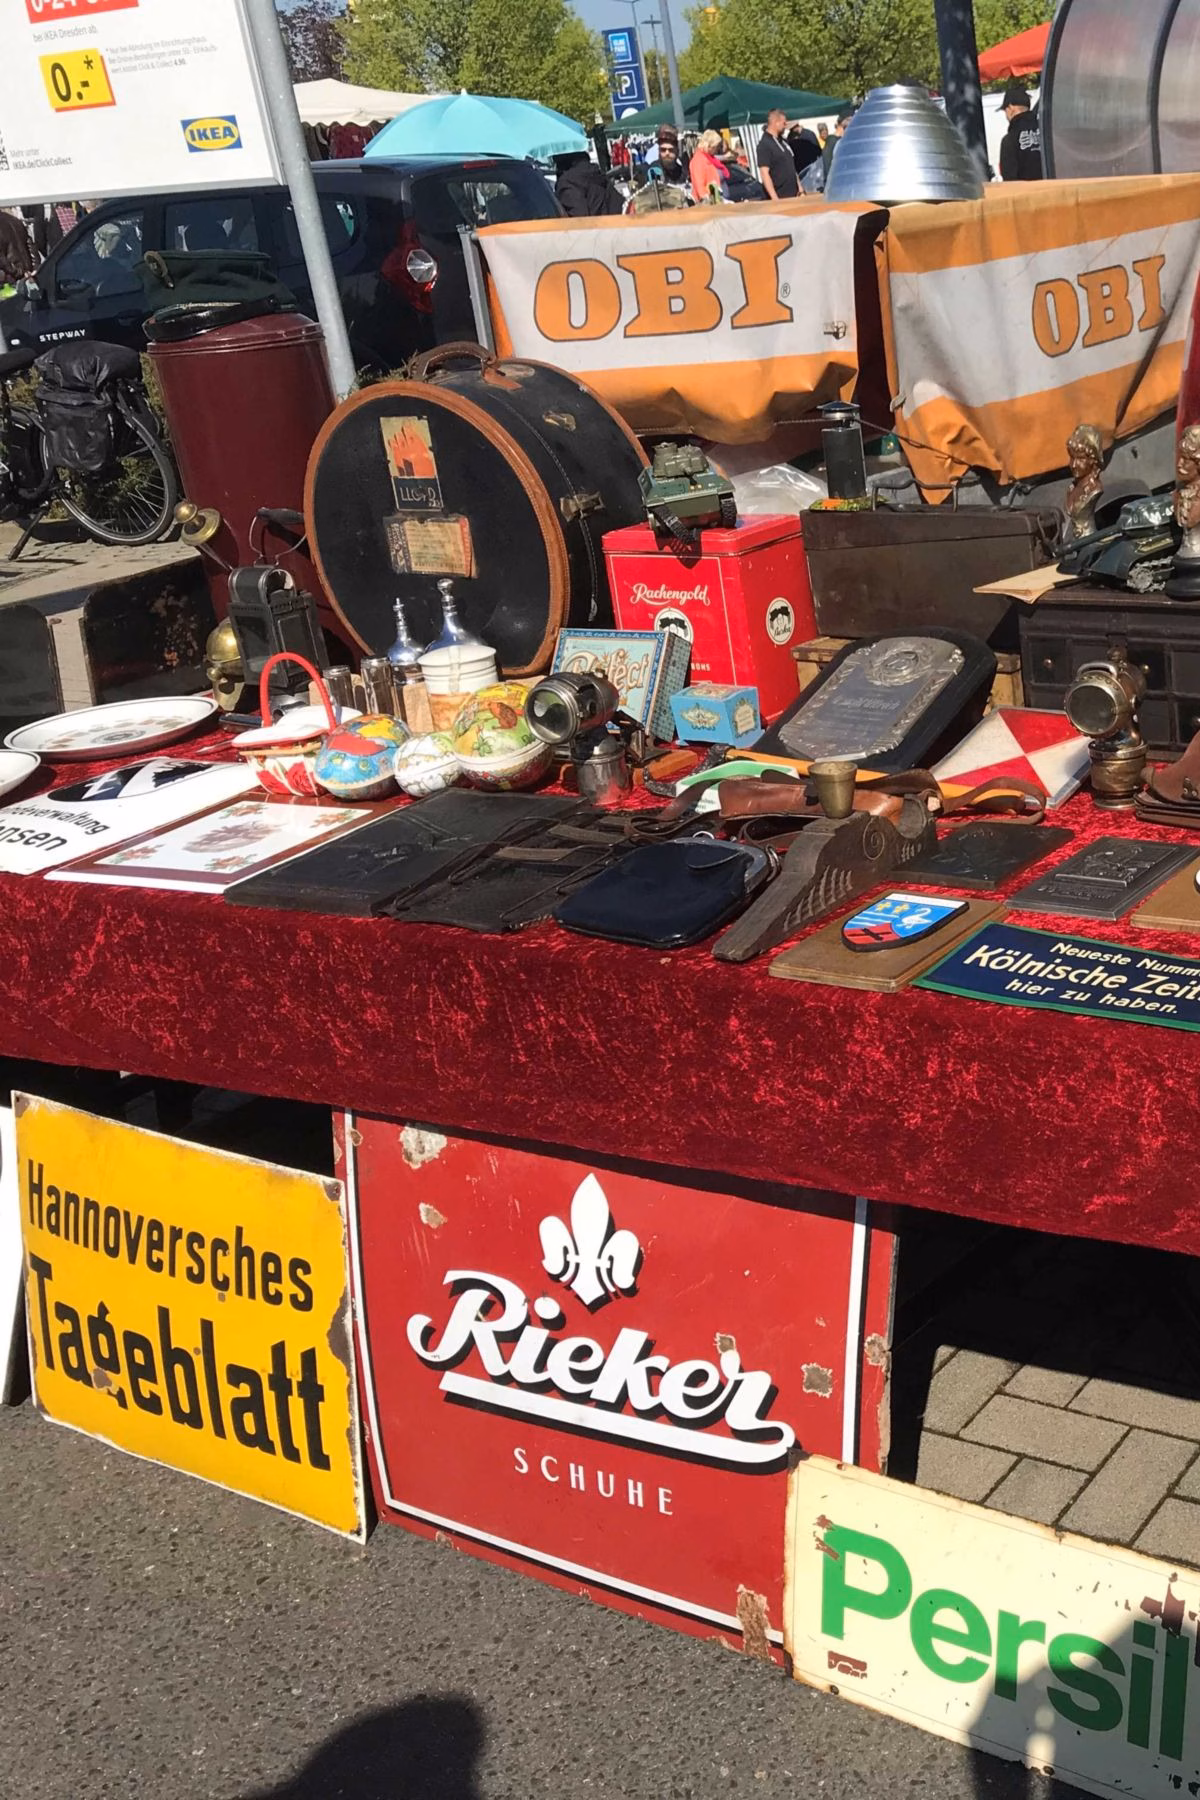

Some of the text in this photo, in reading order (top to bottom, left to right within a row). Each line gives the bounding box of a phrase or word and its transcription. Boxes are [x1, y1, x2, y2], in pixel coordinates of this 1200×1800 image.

[620, 74, 632, 95] P
[188, 125, 237, 143] IKEA
[533, 233, 794, 343] OBI
[1031, 254, 1167, 359] OBI
[39, 328, 87, 342] STEPWAY
[630, 582, 712, 607] Rachengold
[0, 823, 68, 852] nsen
[963, 943, 1130, 989] Kölnische
[1050, 941, 1133, 967] Neueste
[1004, 978, 1179, 1015] hier zu haben.
[28, 1158, 314, 1312] Hannoversches
[30, 1251, 332, 1472] Tageblatt
[407, 1270, 796, 1455] Rieker
[512, 1446, 674, 1517] SCHUHE
[820, 1524, 1190, 1762] Persil
